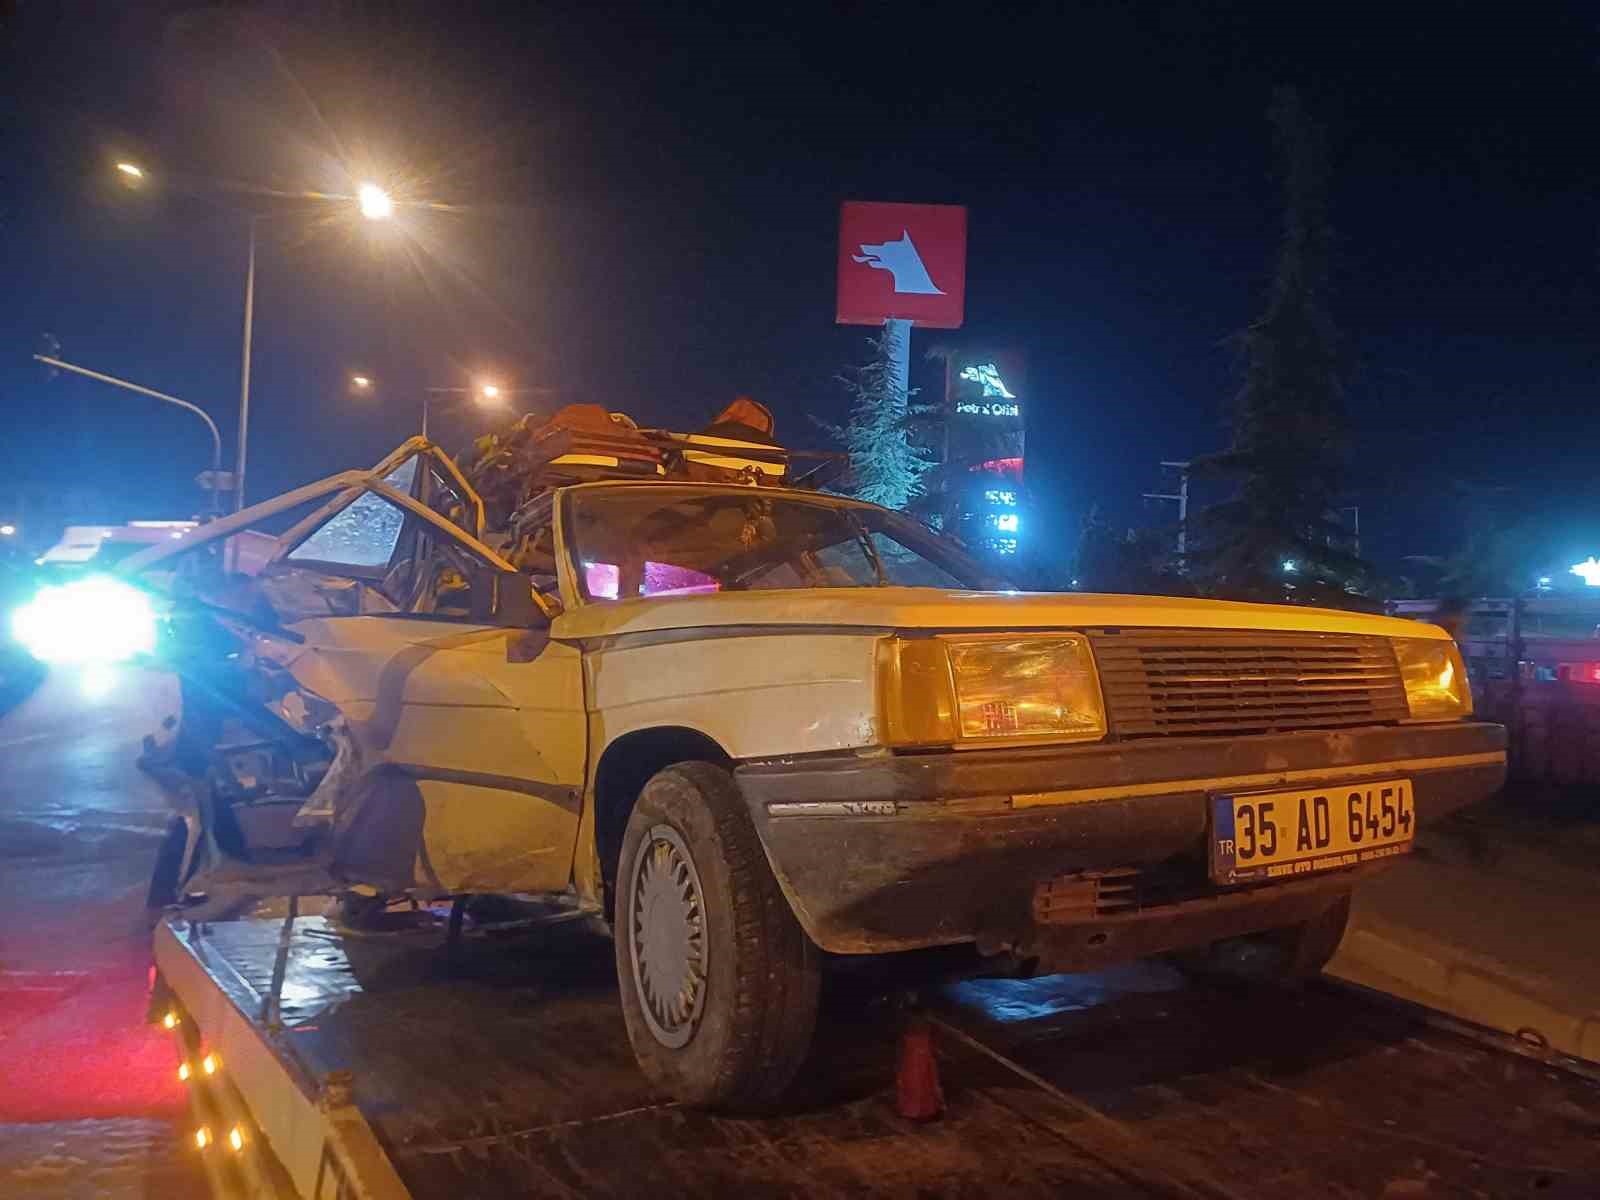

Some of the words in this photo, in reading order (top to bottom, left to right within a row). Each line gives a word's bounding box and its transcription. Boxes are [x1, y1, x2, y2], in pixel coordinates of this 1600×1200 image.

[1236, 802, 1277, 859] 35
[1296, 796, 1330, 851] AD
[1347, 786, 1411, 843] 6454
[1218, 839, 1234, 856] TR
